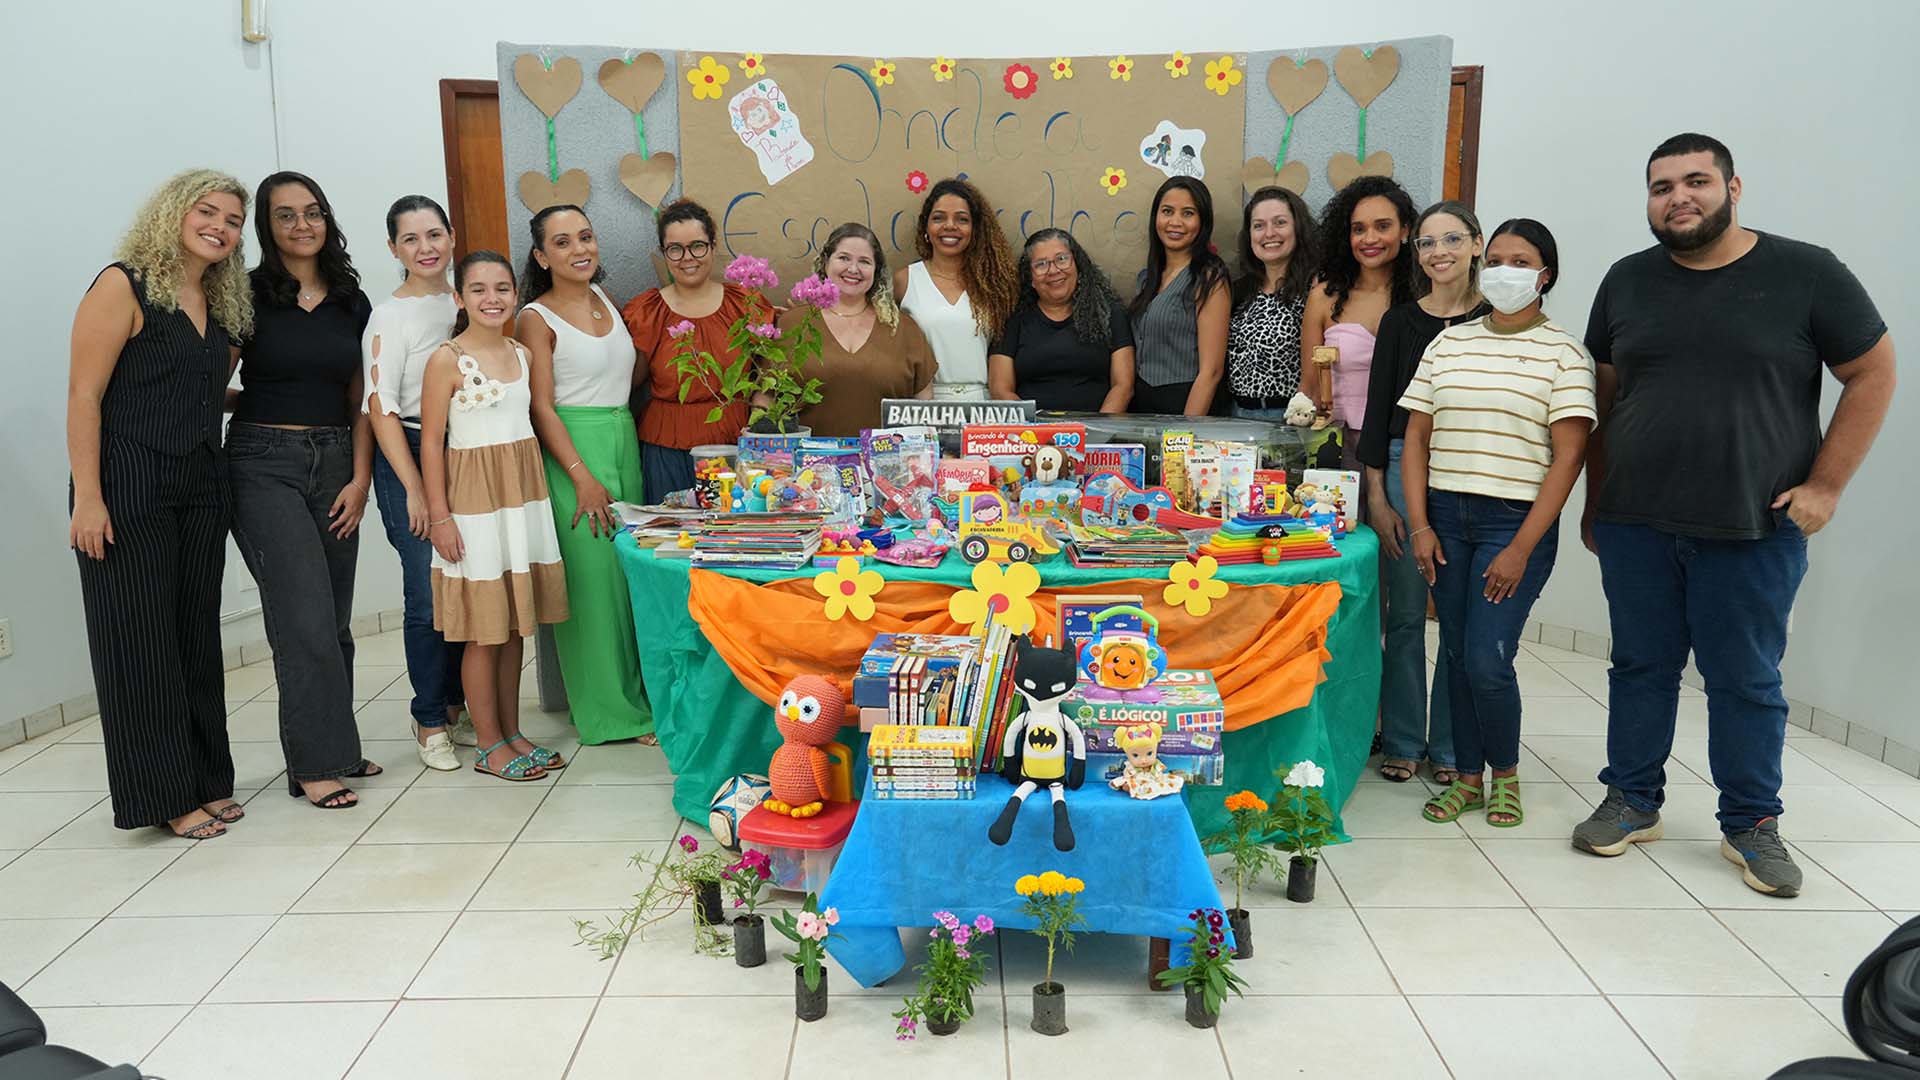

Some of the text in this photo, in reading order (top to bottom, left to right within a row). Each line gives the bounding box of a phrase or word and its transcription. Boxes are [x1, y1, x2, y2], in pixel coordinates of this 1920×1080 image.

[824, 63, 1100, 163] Onde a
[887, 405, 1026, 425] BATALHA NAVAL
[967, 431, 997, 441] Brincando
[998, 431, 1006, 440] de
[1053, 432, 1081, 447] 150
[967, 440, 1037, 457] Engenheiro
[1085, 451, 1121, 466] MÓRIA
